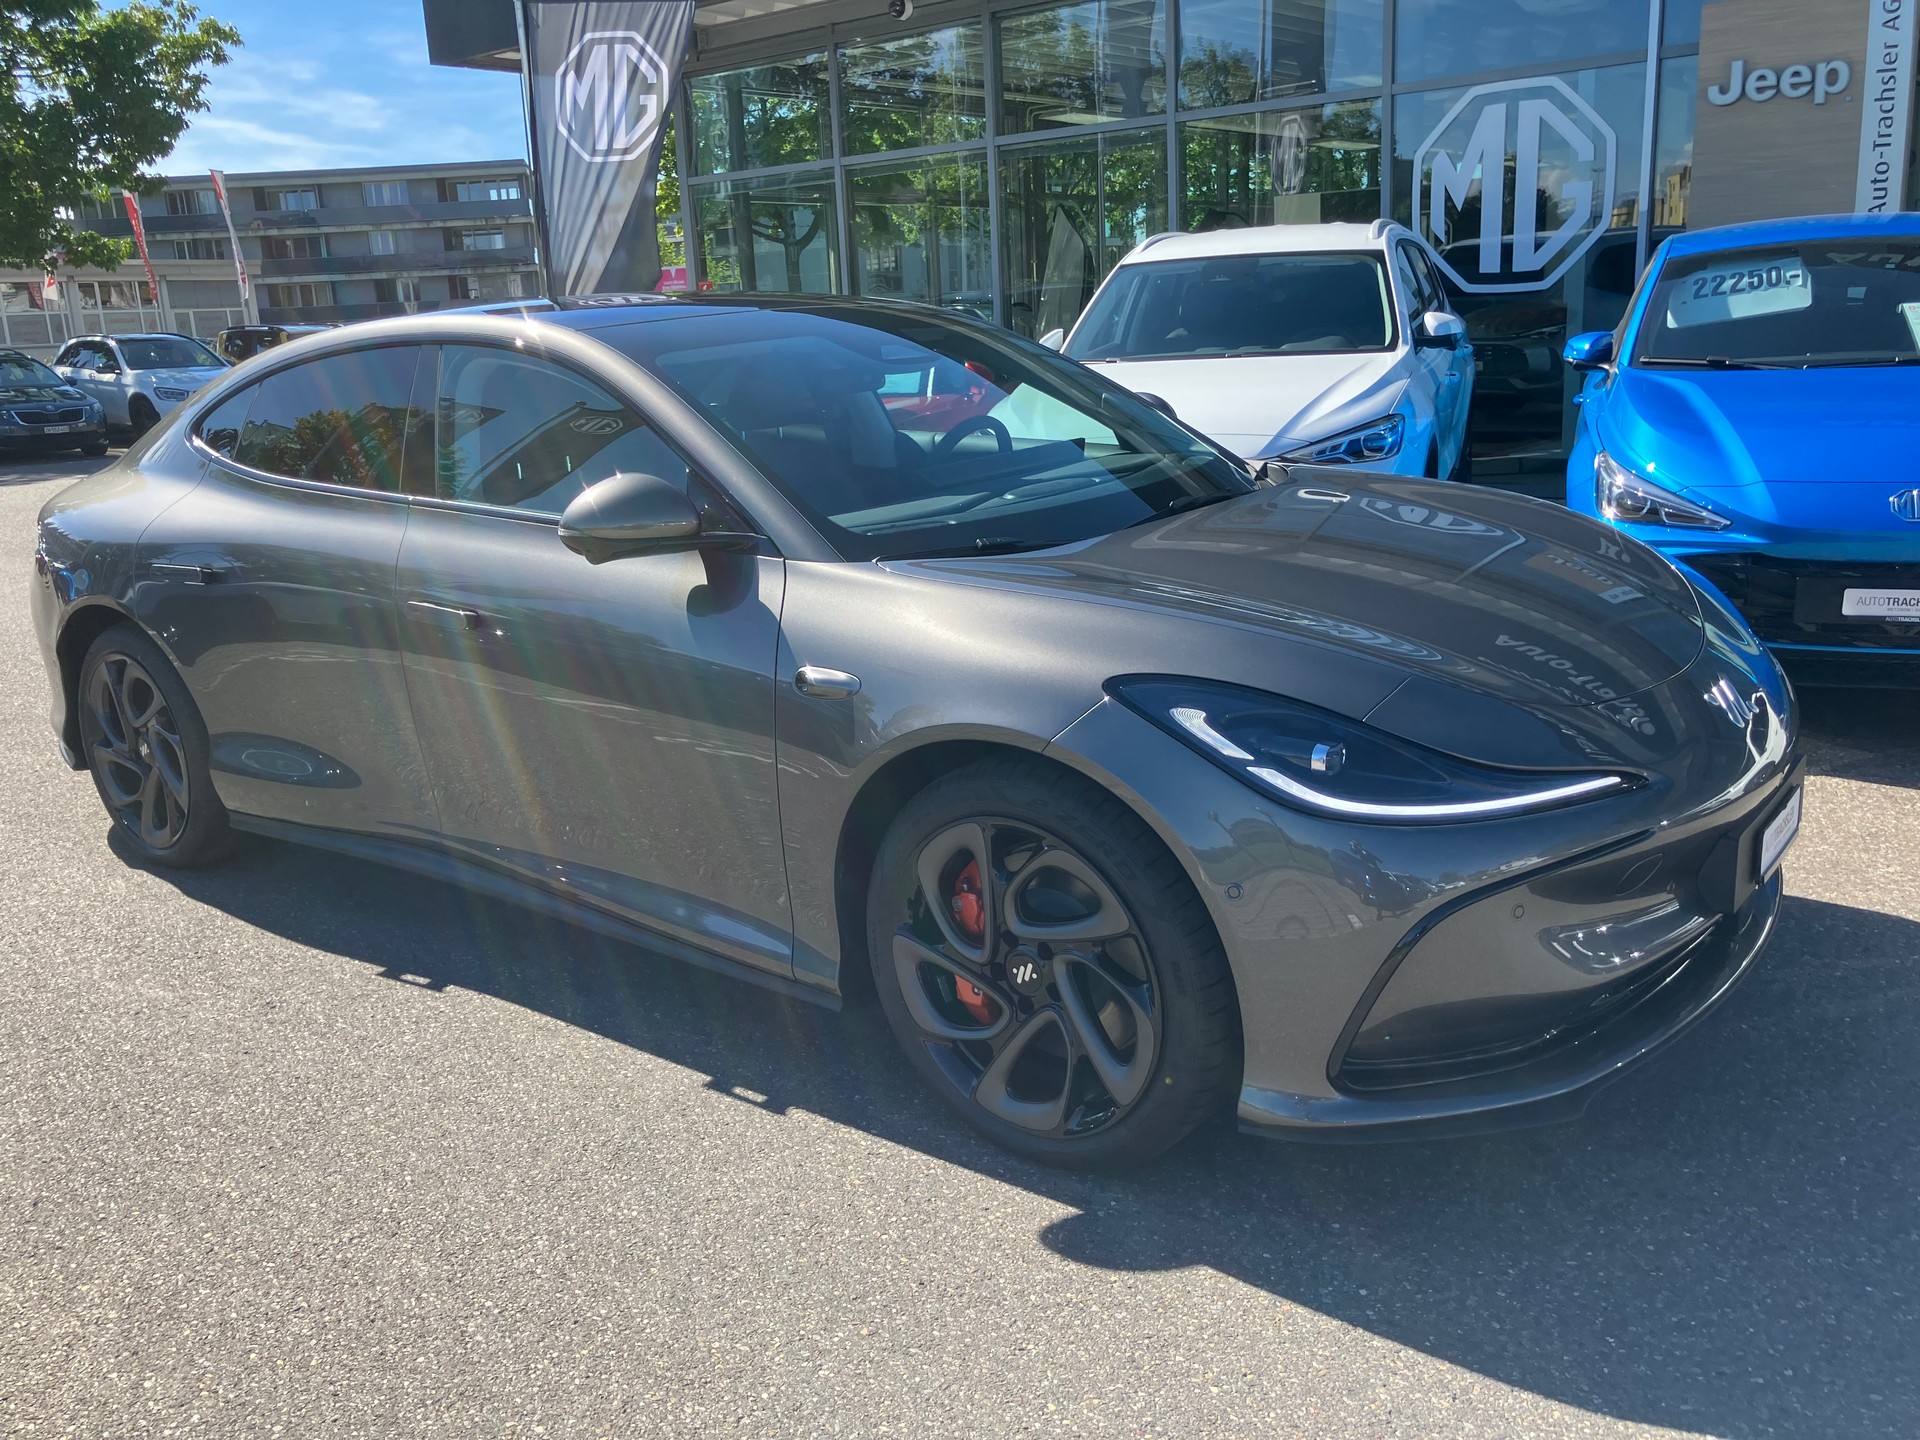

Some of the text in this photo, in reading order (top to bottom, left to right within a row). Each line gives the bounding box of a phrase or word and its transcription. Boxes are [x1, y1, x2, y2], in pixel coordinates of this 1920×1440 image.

[563, 42, 660, 152] MG
[1706, 59, 1851, 107] Jeep
[1867, 0, 1902, 213] Auto-Trachsler AG
[1428, 98, 1596, 274] MG
[1692, 265, 1801, 300] 22250.-
